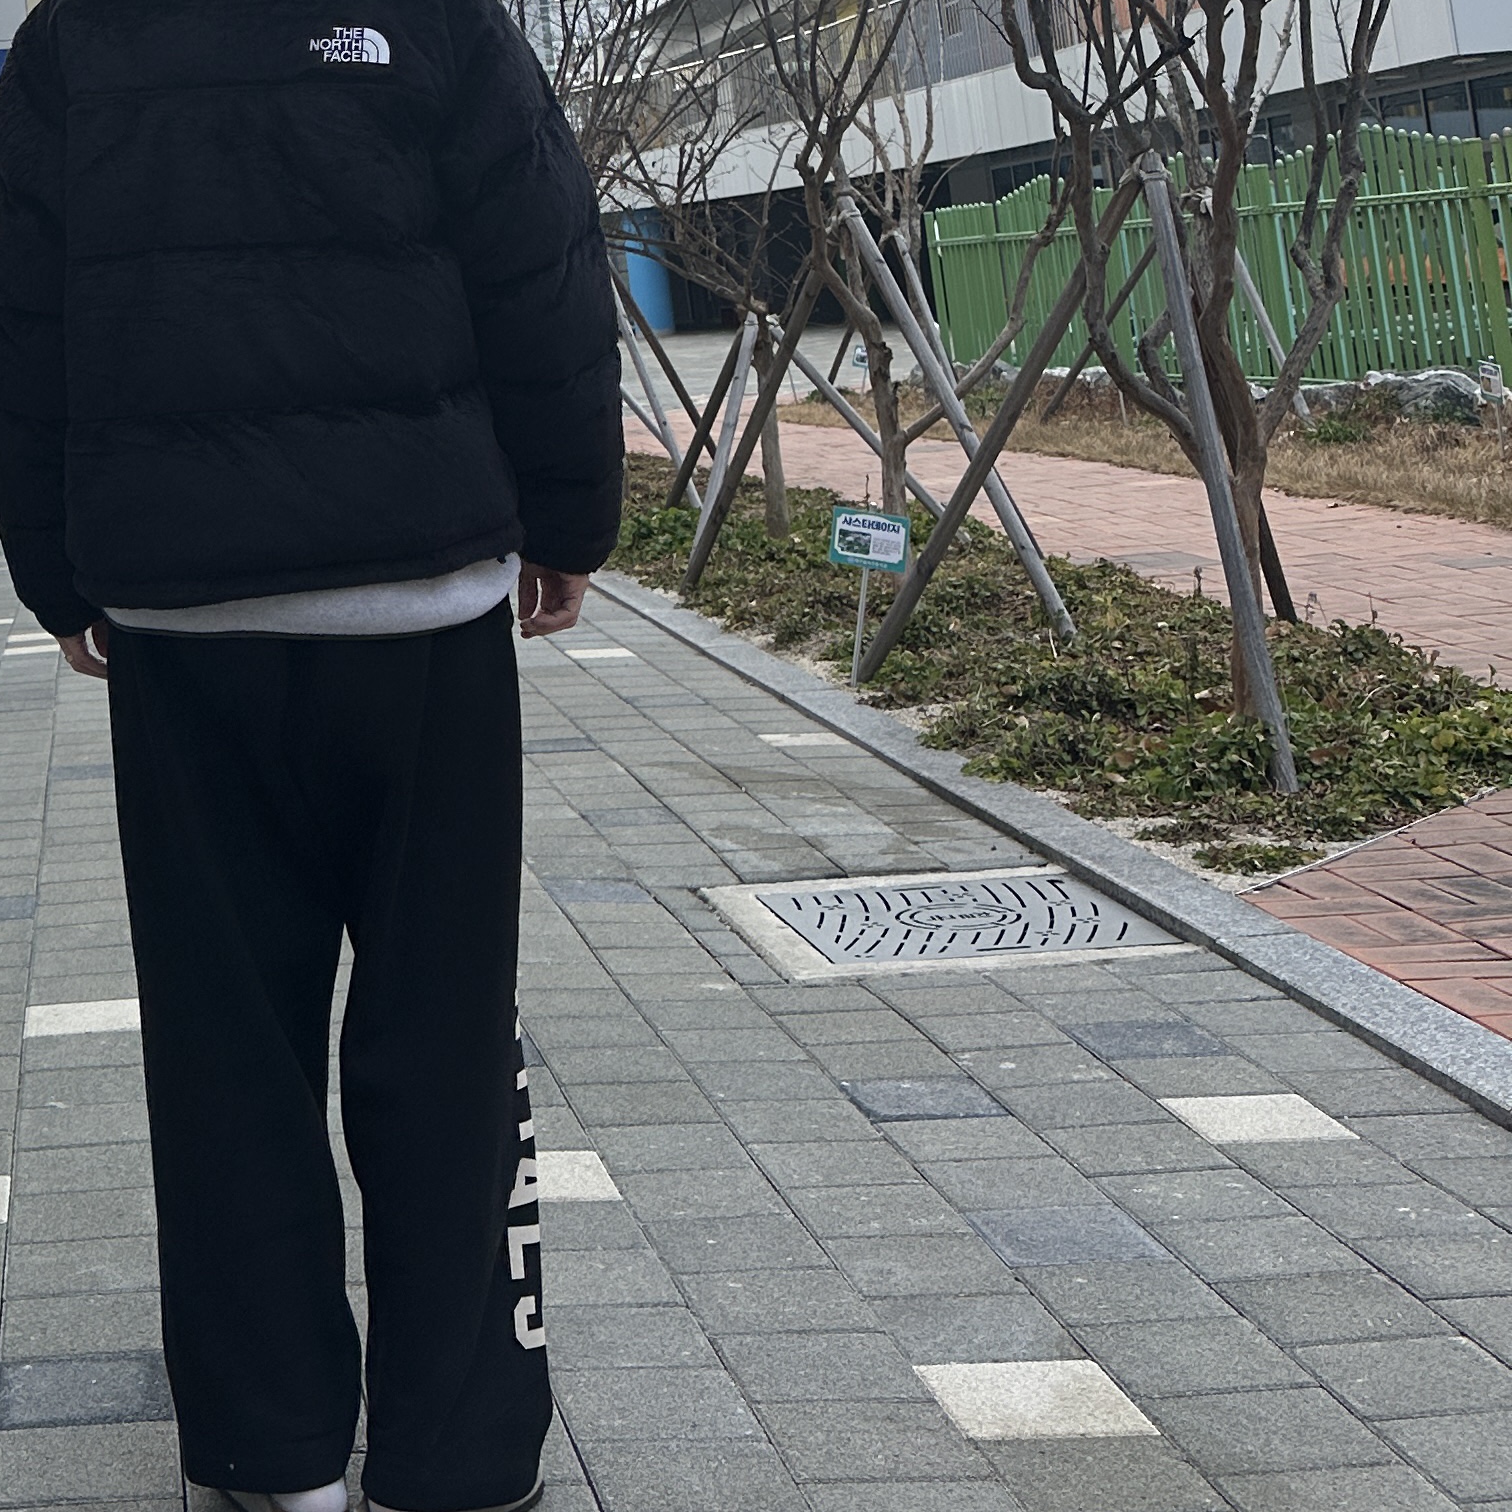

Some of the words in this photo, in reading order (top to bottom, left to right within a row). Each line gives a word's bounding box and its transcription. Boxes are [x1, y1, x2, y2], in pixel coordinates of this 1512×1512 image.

[332, 27, 363, 39] THE
[309, 38, 362, 51] NORTH
[323, 50, 361, 62] FACE
